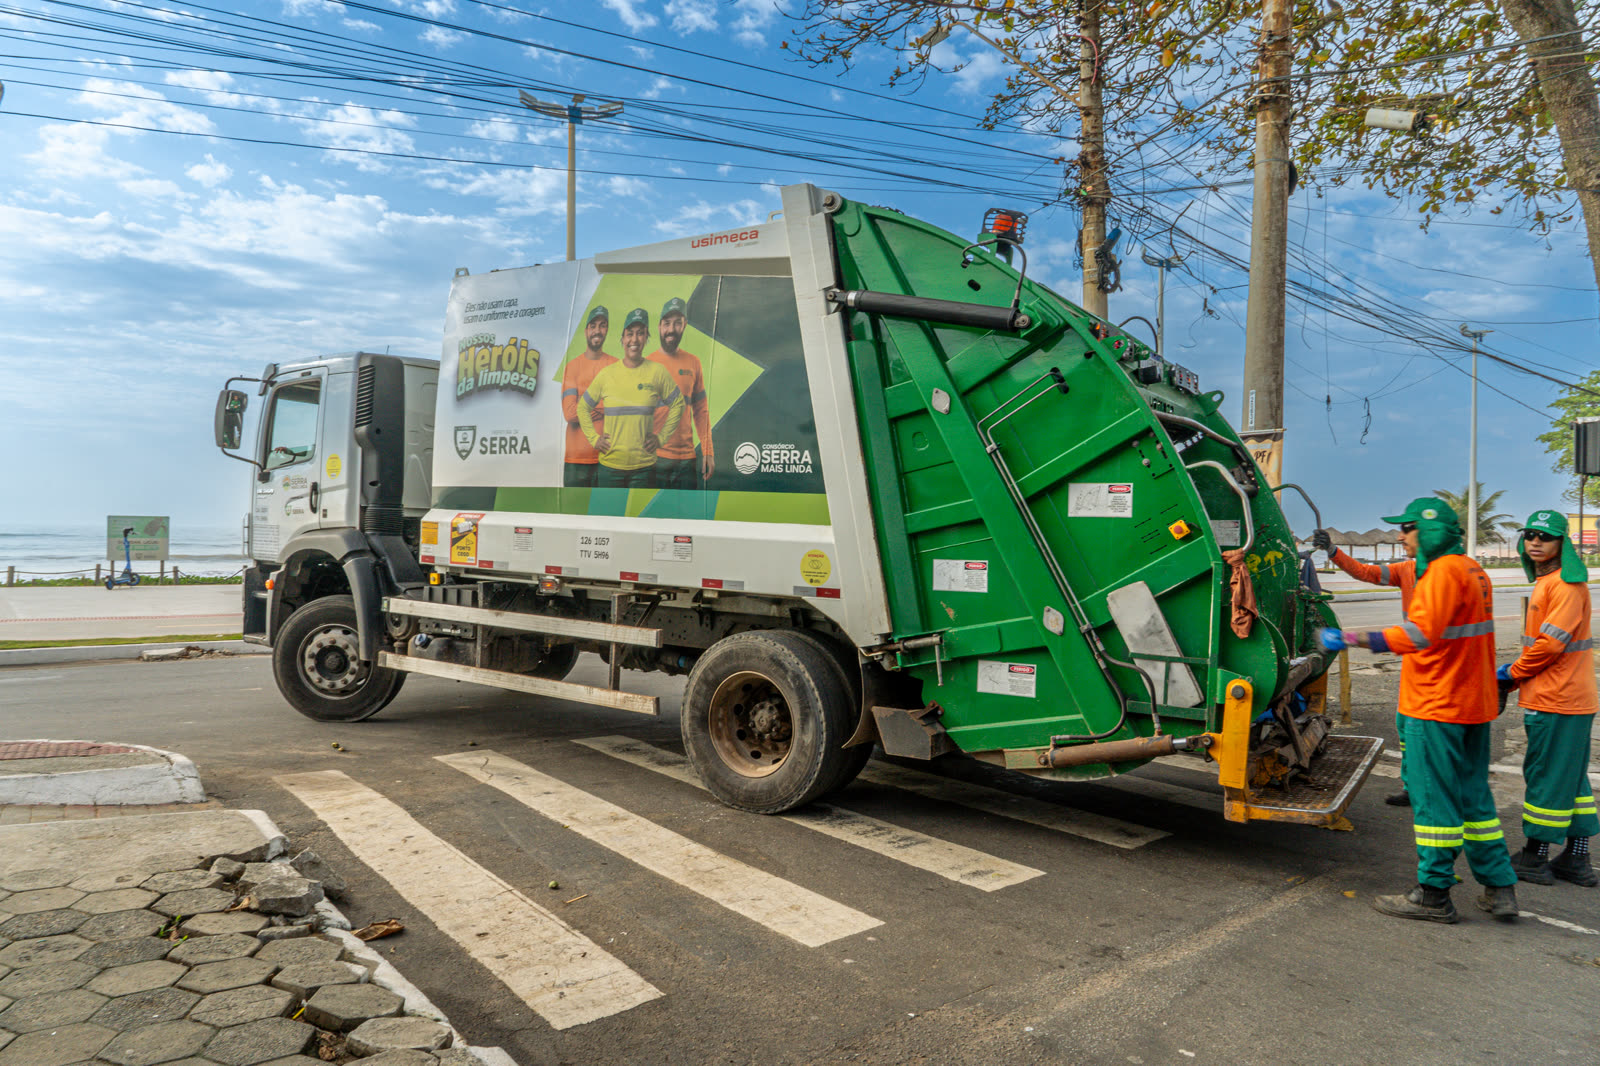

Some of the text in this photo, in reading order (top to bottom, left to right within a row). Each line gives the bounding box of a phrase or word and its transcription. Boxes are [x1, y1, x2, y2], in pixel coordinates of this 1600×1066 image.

[691, 229, 760, 249] usimeca
[465, 302, 476, 313] Eles
[477, 301, 488, 311] não
[488, 300, 503, 310] usam
[464, 315, 479, 324] usam
[484, 310, 509, 322] uniforme
[514, 309, 519, 318] a
[458, 337, 540, 382] Heróis
[456, 369, 537, 397] da limpeza
[479, 436, 531, 455] SERRA
[761, 450, 813, 464] SERRA
[761, 465, 813, 474] MAIS LINDA
[580, 536, 610, 545] 126 1057
[580, 550, 610, 559] TTV 5H96
